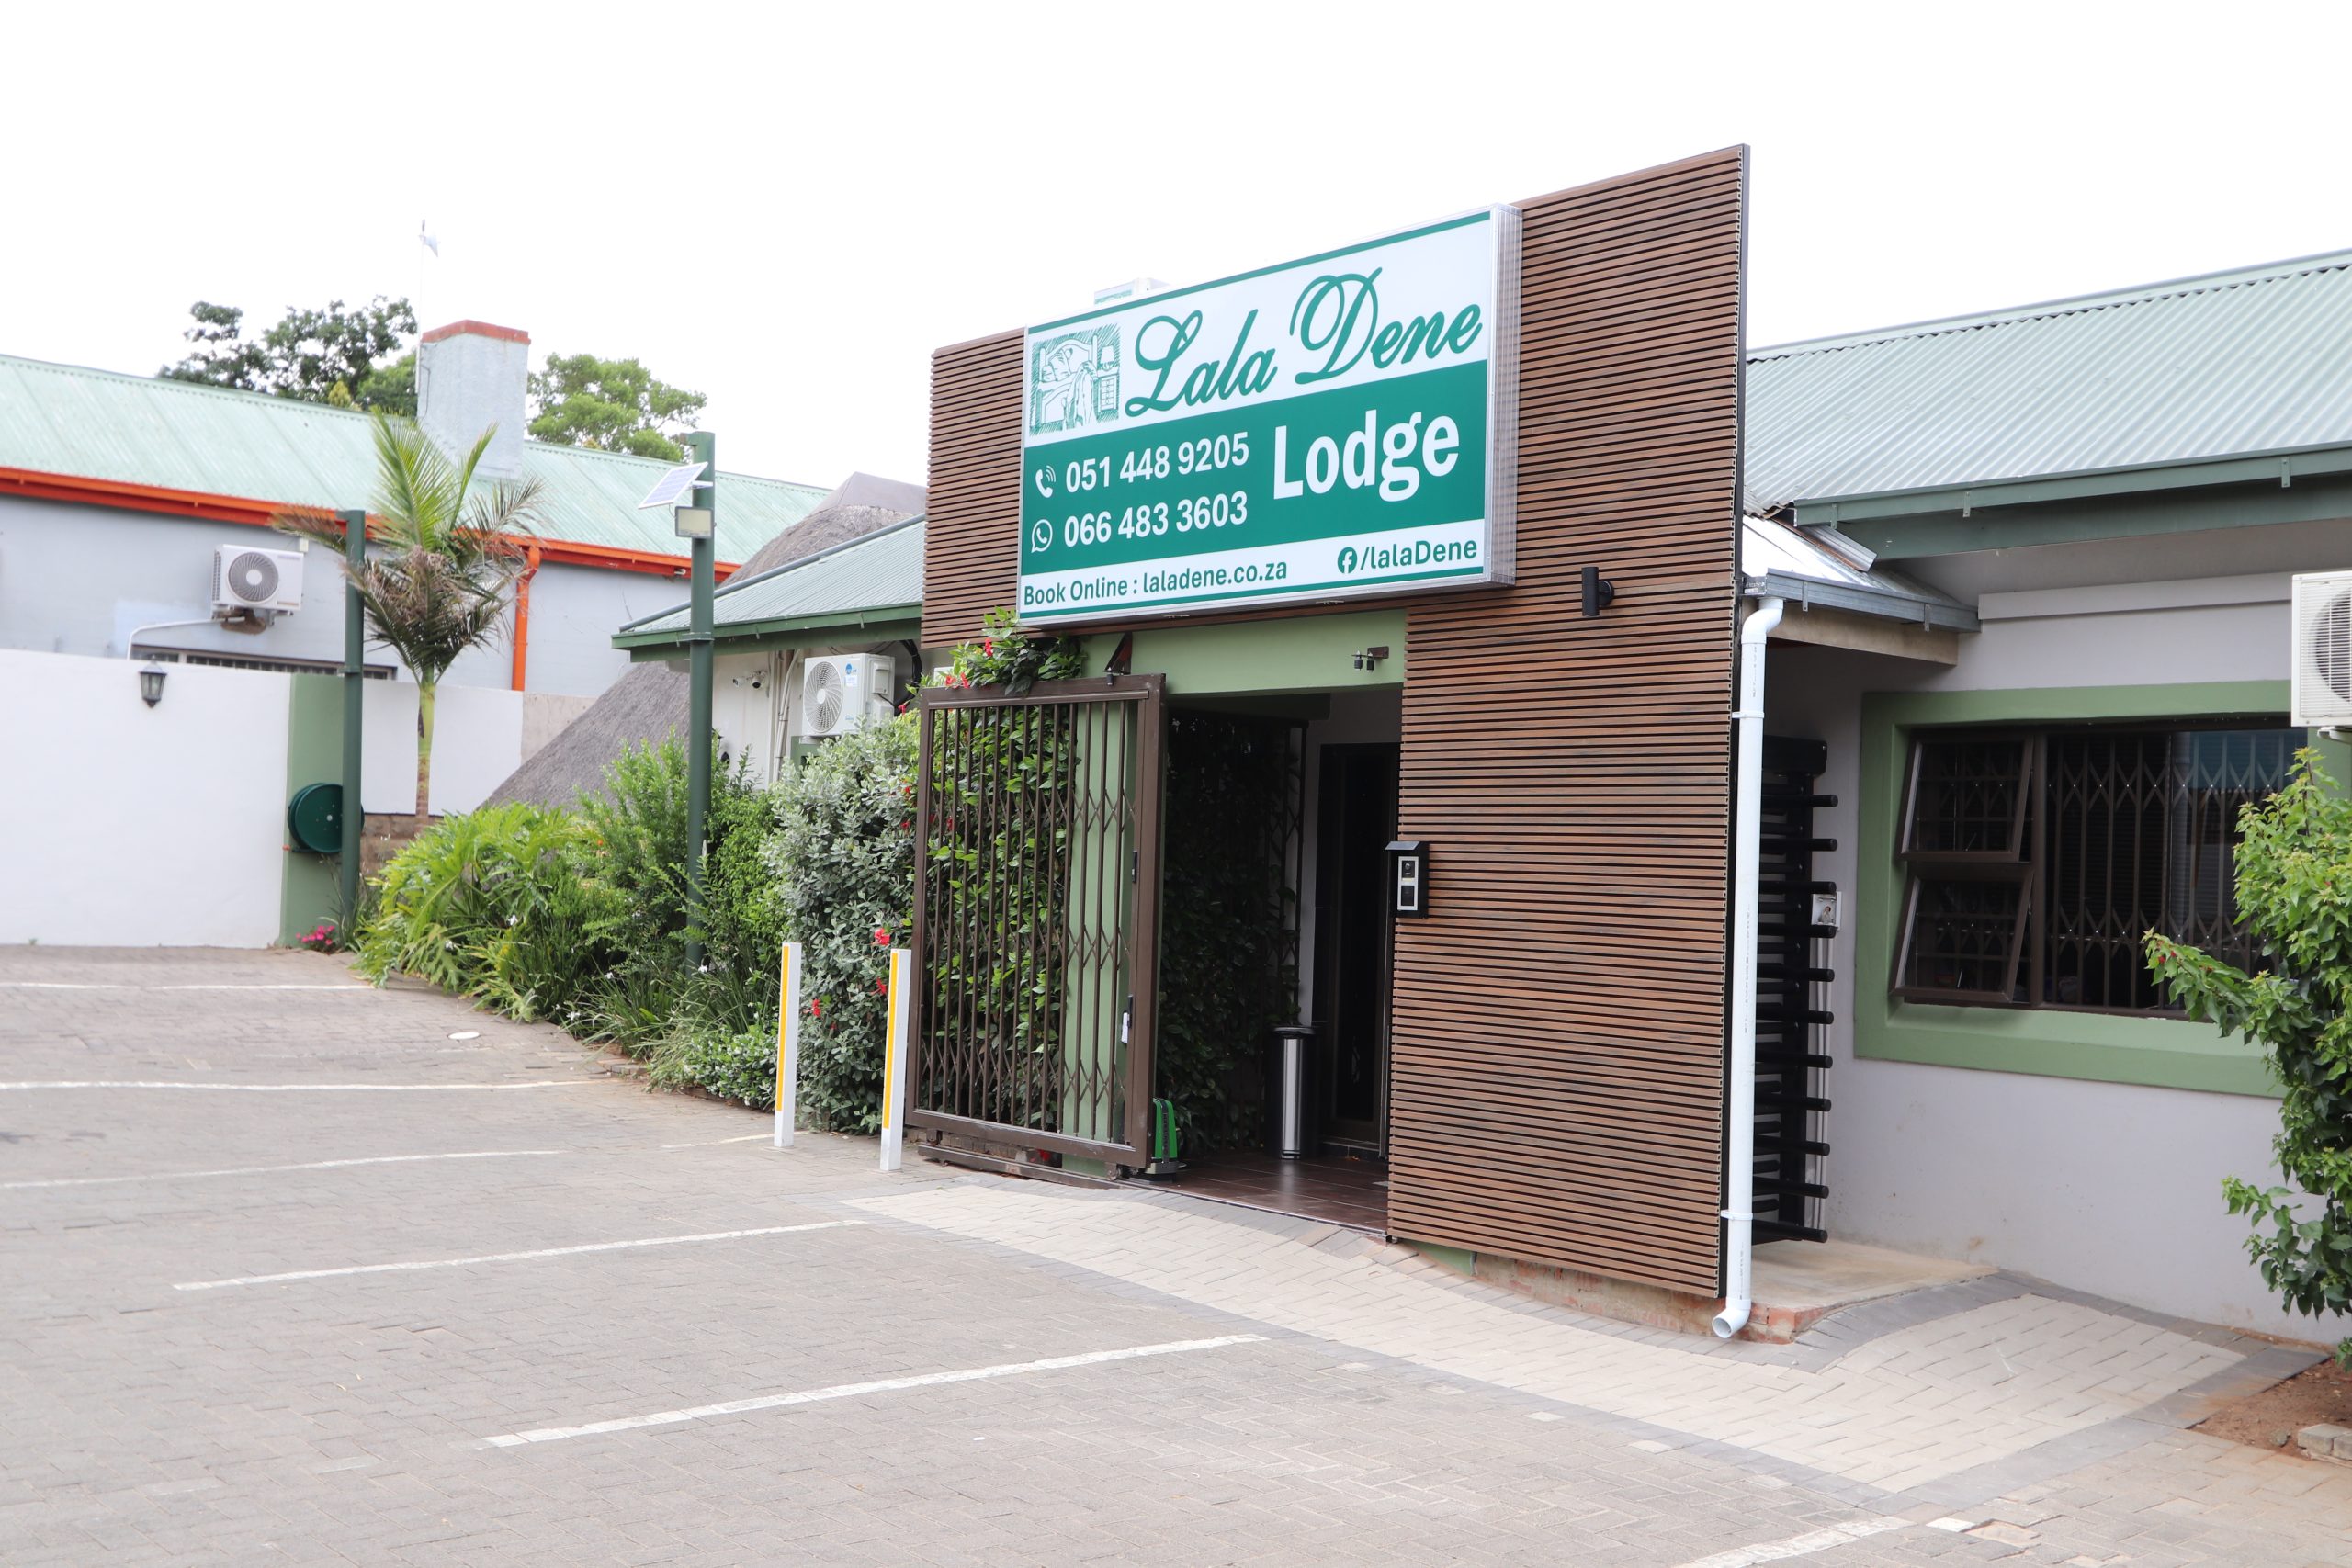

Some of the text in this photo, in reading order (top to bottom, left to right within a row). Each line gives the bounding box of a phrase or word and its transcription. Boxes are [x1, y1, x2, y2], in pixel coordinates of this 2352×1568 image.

[1125, 267, 1483, 418] Lala Dene
[1065, 431, 1250, 493] 051 448 9205
[1273, 409, 1460, 502] Lodge
[1063, 491, 1248, 547] 066 483 3603
[1023, 561, 1287, 605] Book Online : laladene.co.za
[1360, 540, 1477, 570] /lalaDene
